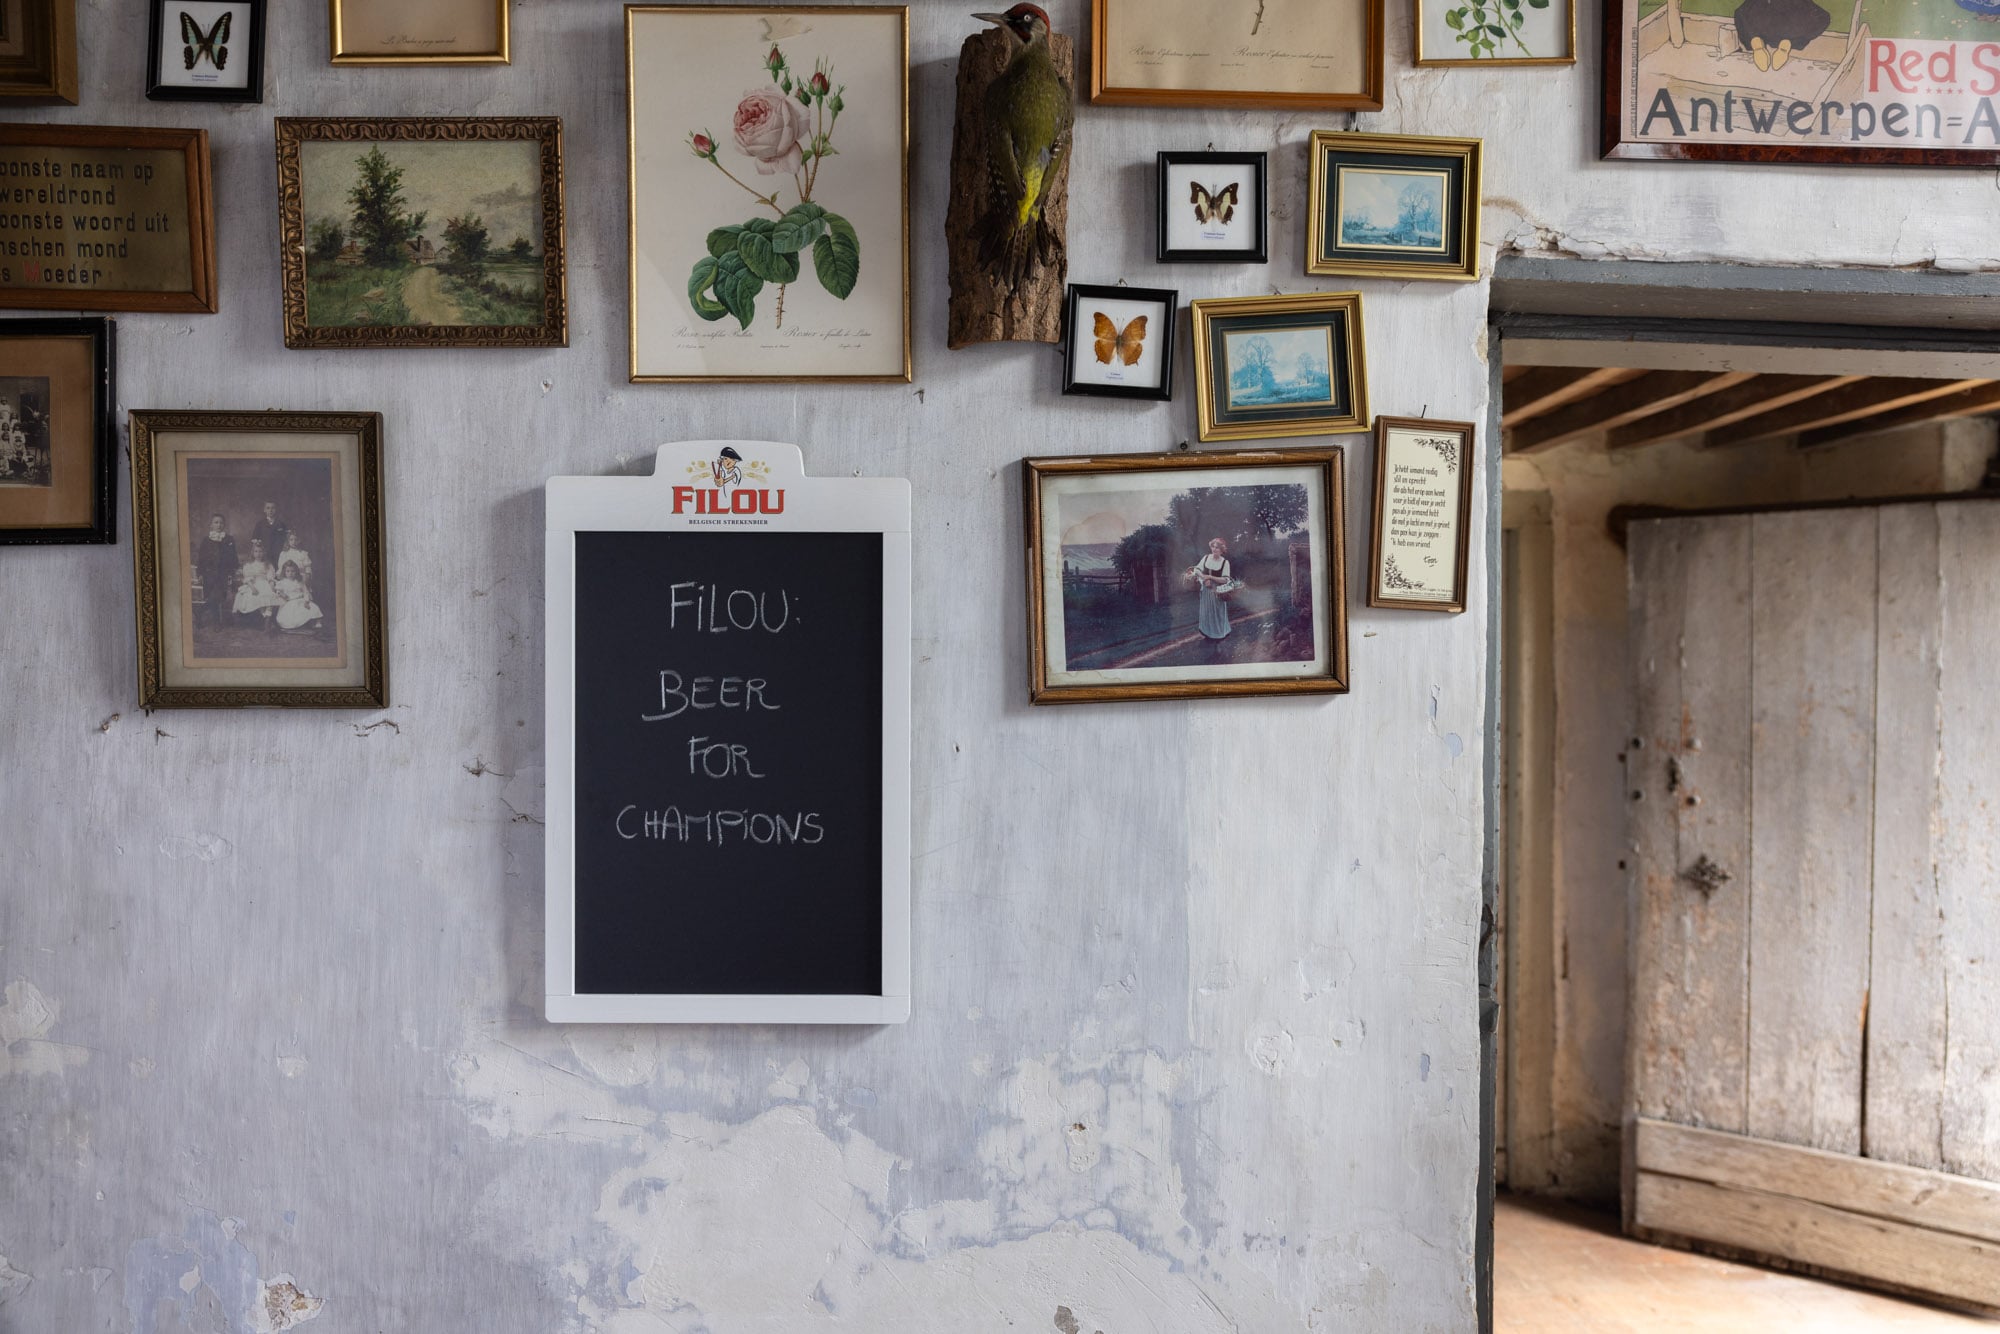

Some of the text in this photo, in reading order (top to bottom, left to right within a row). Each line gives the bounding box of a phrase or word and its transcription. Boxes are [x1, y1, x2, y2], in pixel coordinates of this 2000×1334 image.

[1868, 40, 2000, 96] Red S
[71, 162, 124, 179] naam
[134, 163, 153, 186] op
[0, 184, 115, 205] wereldrond
[73, 212, 136, 232] woord
[145, 212, 170, 233] uit
[77, 238, 128, 258] mond
[24, 260, 102, 284] Moeder
[671, 486, 785, 514] FILOU
[641, 669, 781, 721] BEER
[688, 736, 765, 778] FOR
